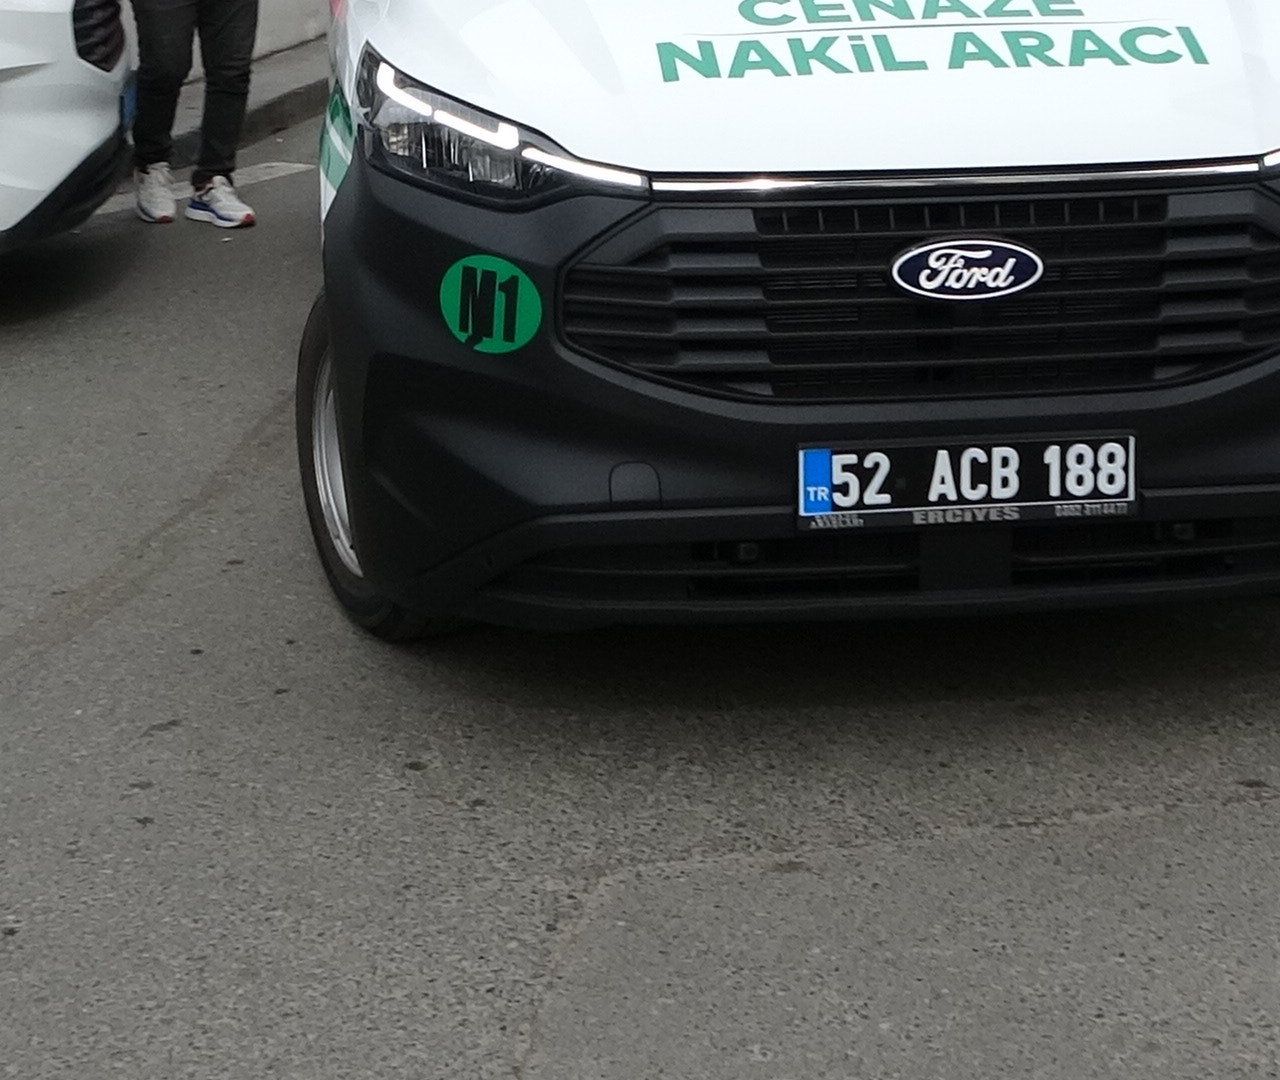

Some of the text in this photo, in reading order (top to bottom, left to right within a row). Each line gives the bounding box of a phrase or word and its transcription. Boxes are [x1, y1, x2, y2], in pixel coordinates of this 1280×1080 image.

[946, 25, 1211, 70] ARACI
[918, 249, 1017, 290] Ford
[458, 264, 520, 344] N1
[806, 442, 1127, 508] TR 52 ACB 188
